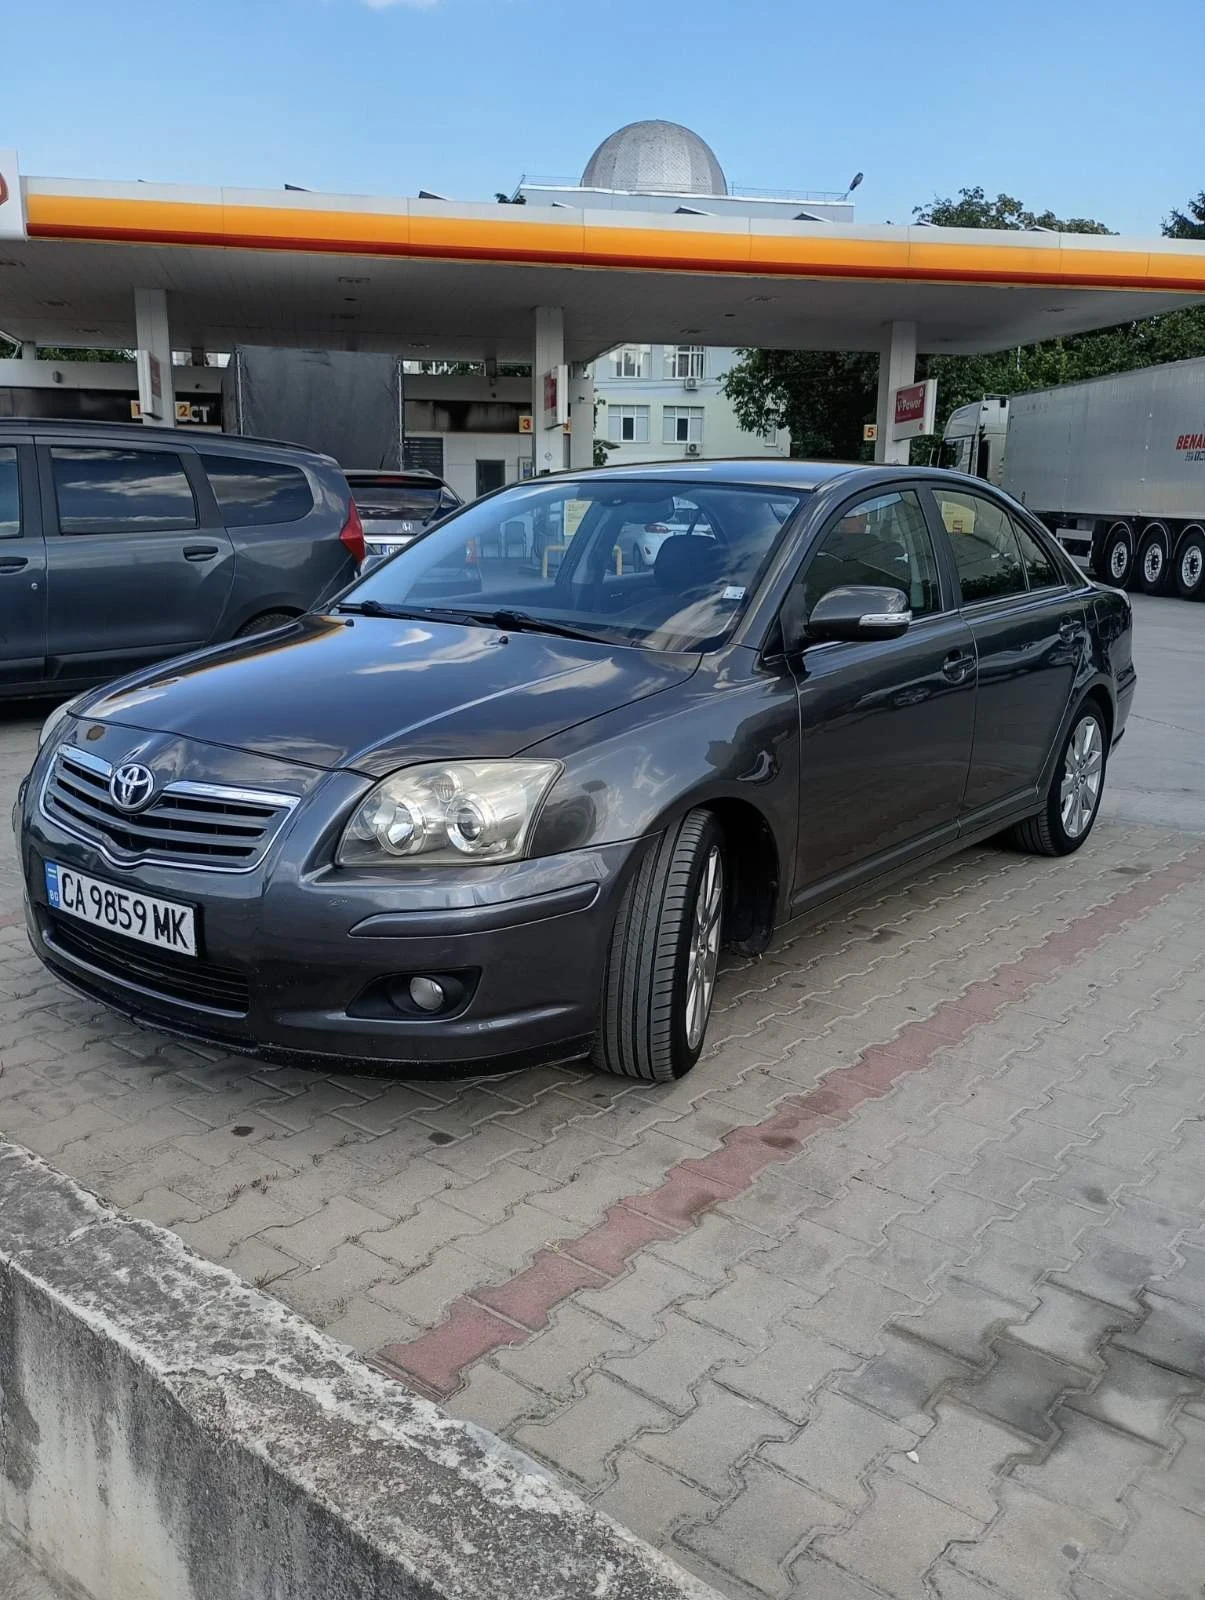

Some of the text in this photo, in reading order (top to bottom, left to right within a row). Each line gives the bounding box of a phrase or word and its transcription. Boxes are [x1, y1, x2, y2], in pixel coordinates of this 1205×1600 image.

[522, 418, 530, 430] 3
[866, 427, 874, 438] 5
[61, 872, 190, 950] CA 9859 MK
